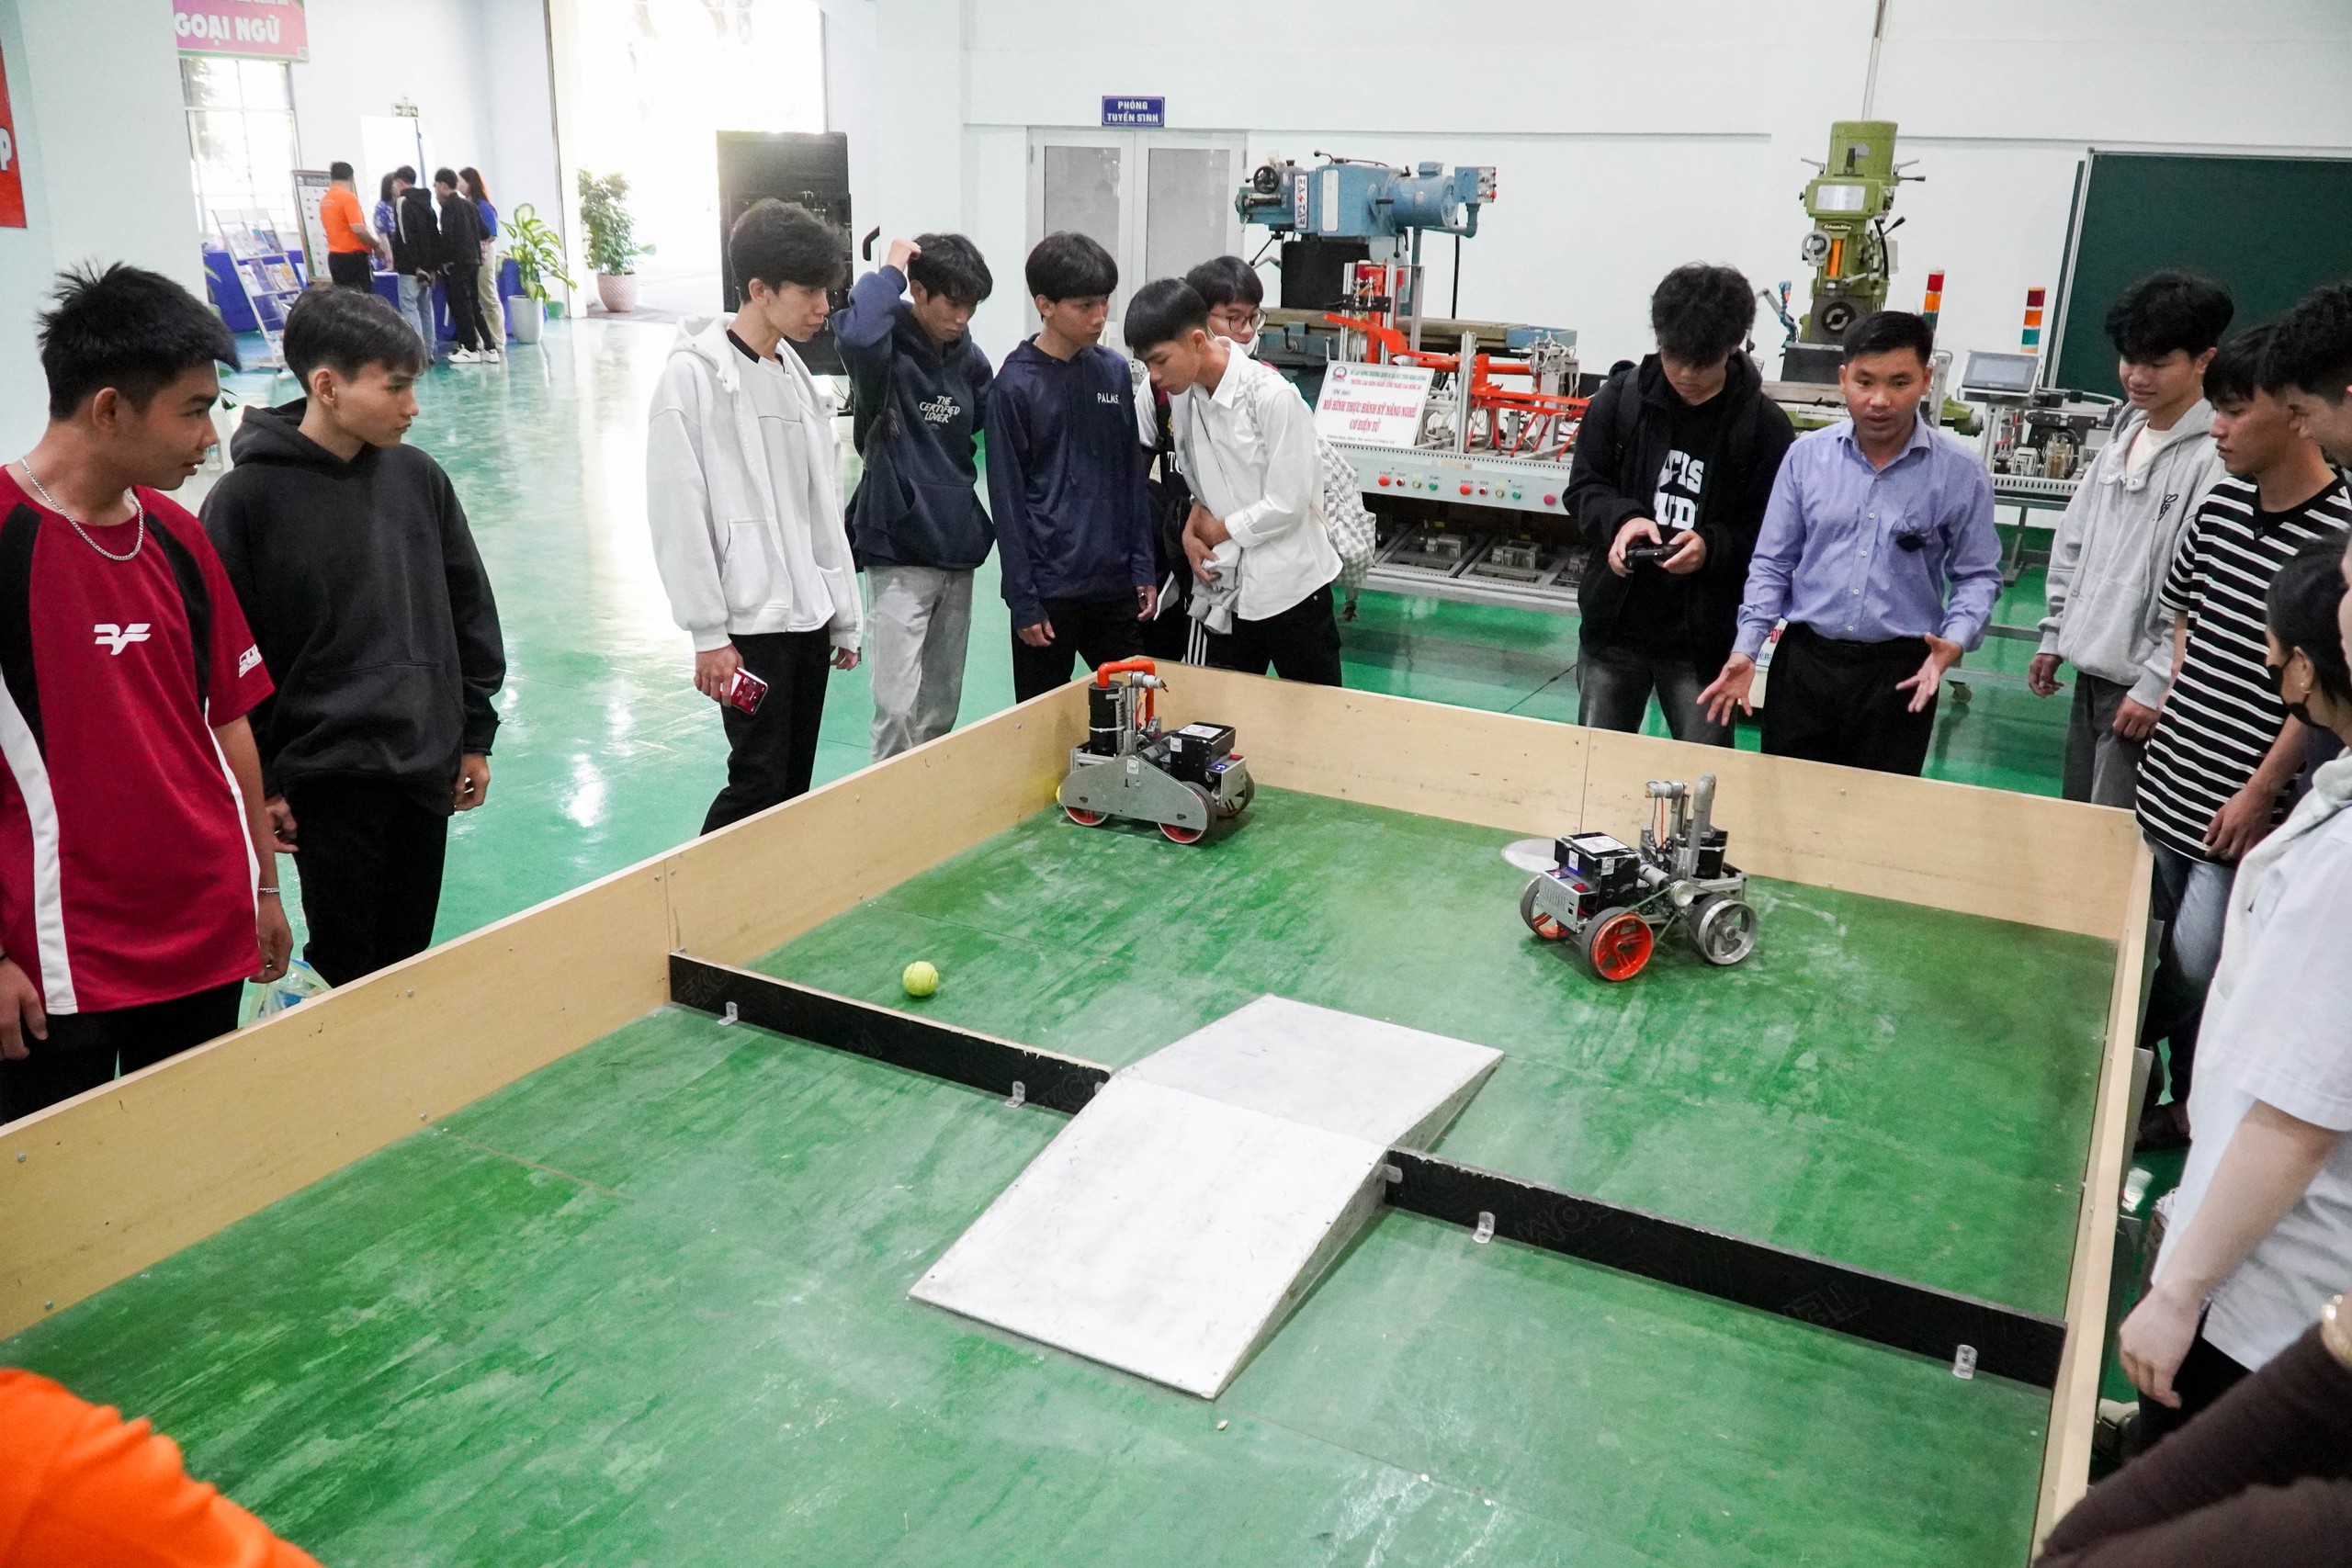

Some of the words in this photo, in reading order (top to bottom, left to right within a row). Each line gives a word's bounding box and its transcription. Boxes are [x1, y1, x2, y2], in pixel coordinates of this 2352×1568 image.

[937, 395, 953, 405] THE
[919, 401, 961, 416] CERTIFIED
[924, 412, 949, 423] LOVER
